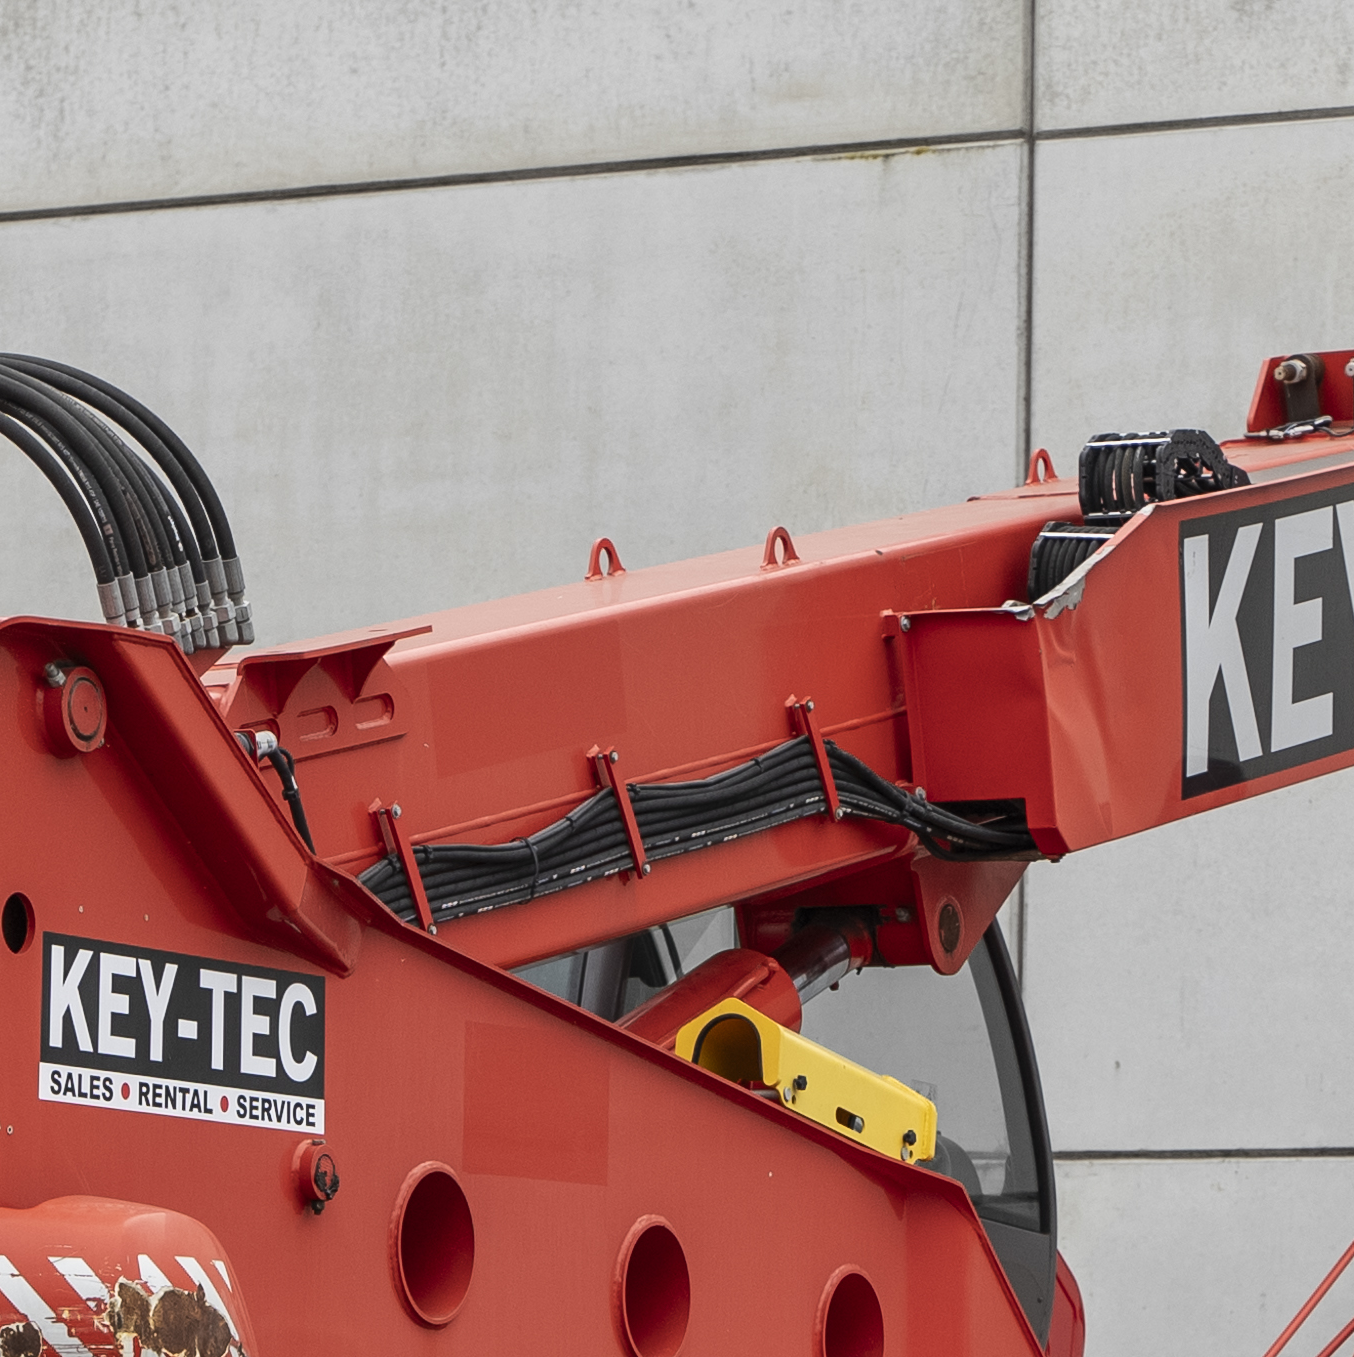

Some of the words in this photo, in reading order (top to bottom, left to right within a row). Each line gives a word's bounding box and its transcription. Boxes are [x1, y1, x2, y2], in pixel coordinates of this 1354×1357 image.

[49, 944, 318, 1083] KEY-TEC
[50, 1070, 114, 1102] SALES
[138, 1081, 213, 1115] RENTAL
[236, 1094, 317, 1128] SERVICE
